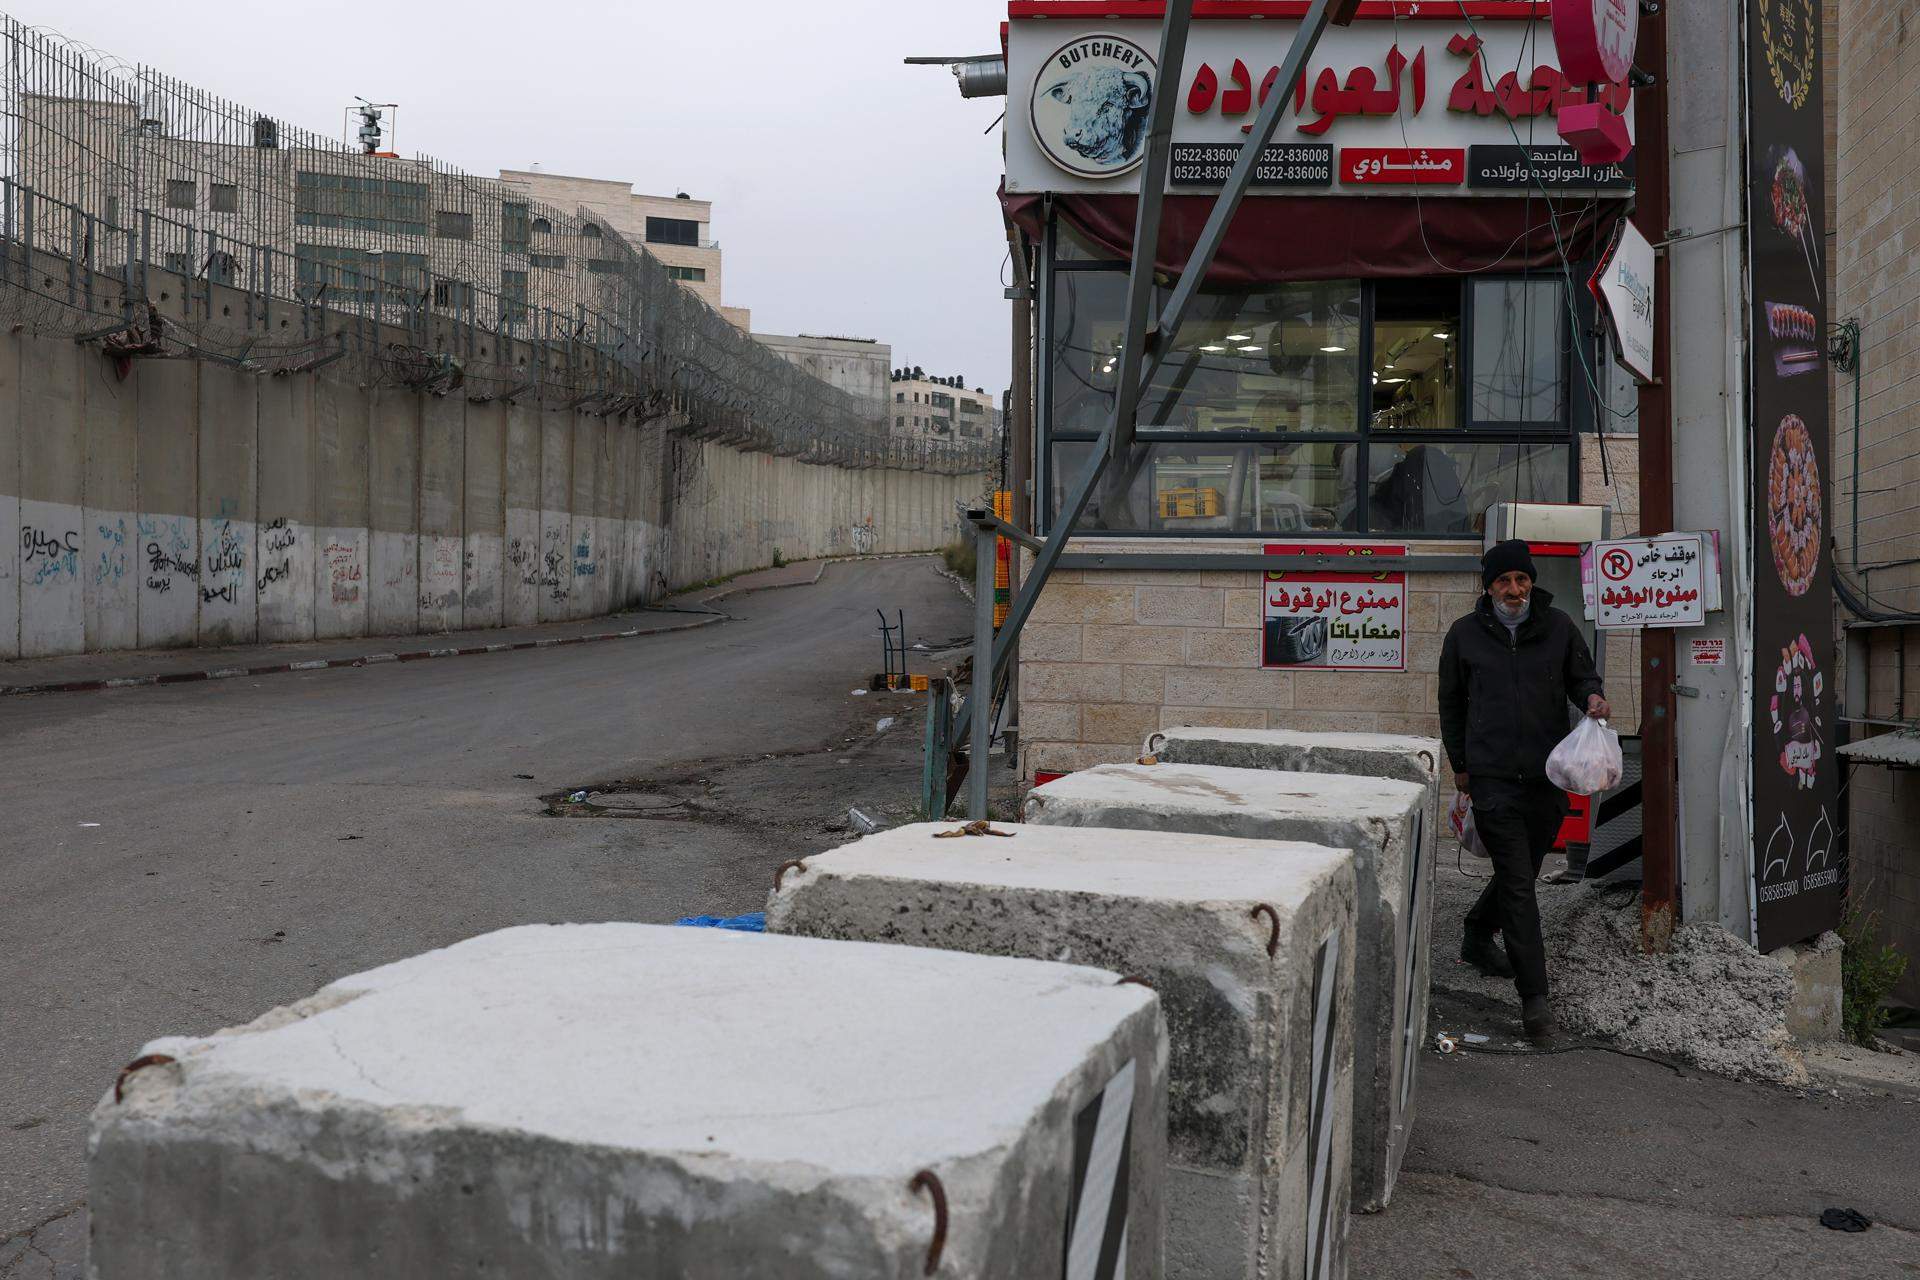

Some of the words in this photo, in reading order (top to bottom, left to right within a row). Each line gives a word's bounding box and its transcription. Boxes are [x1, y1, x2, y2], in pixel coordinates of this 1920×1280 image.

[1058, 42, 1144, 69] BUTCHERY
[1174, 148, 1239, 162] 0522-83600
[1174, 166, 1232, 179] 0522-8360
[1256, 166, 1329, 179] 0522-836006
[1481, 162, 1529, 182] وأولاده
[1637, 548, 1661, 567] خاص
[1664, 545, 1696, 564] موقف
[1651, 568, 1684, 582] الرجاء
[1269, 586, 1337, 613] الوقوف
[1340, 589, 1399, 615] ممنوع
[1601, 584, 1653, 609] الوقوف
[1655, 584, 1698, 609] ممنوع
[1645, 614, 1658, 622] عدم
[1659, 611, 1679, 620] الرجاء
[1759, 879, 1799, 902] 0585855900
[1803, 868, 1838, 890] 0585855900
